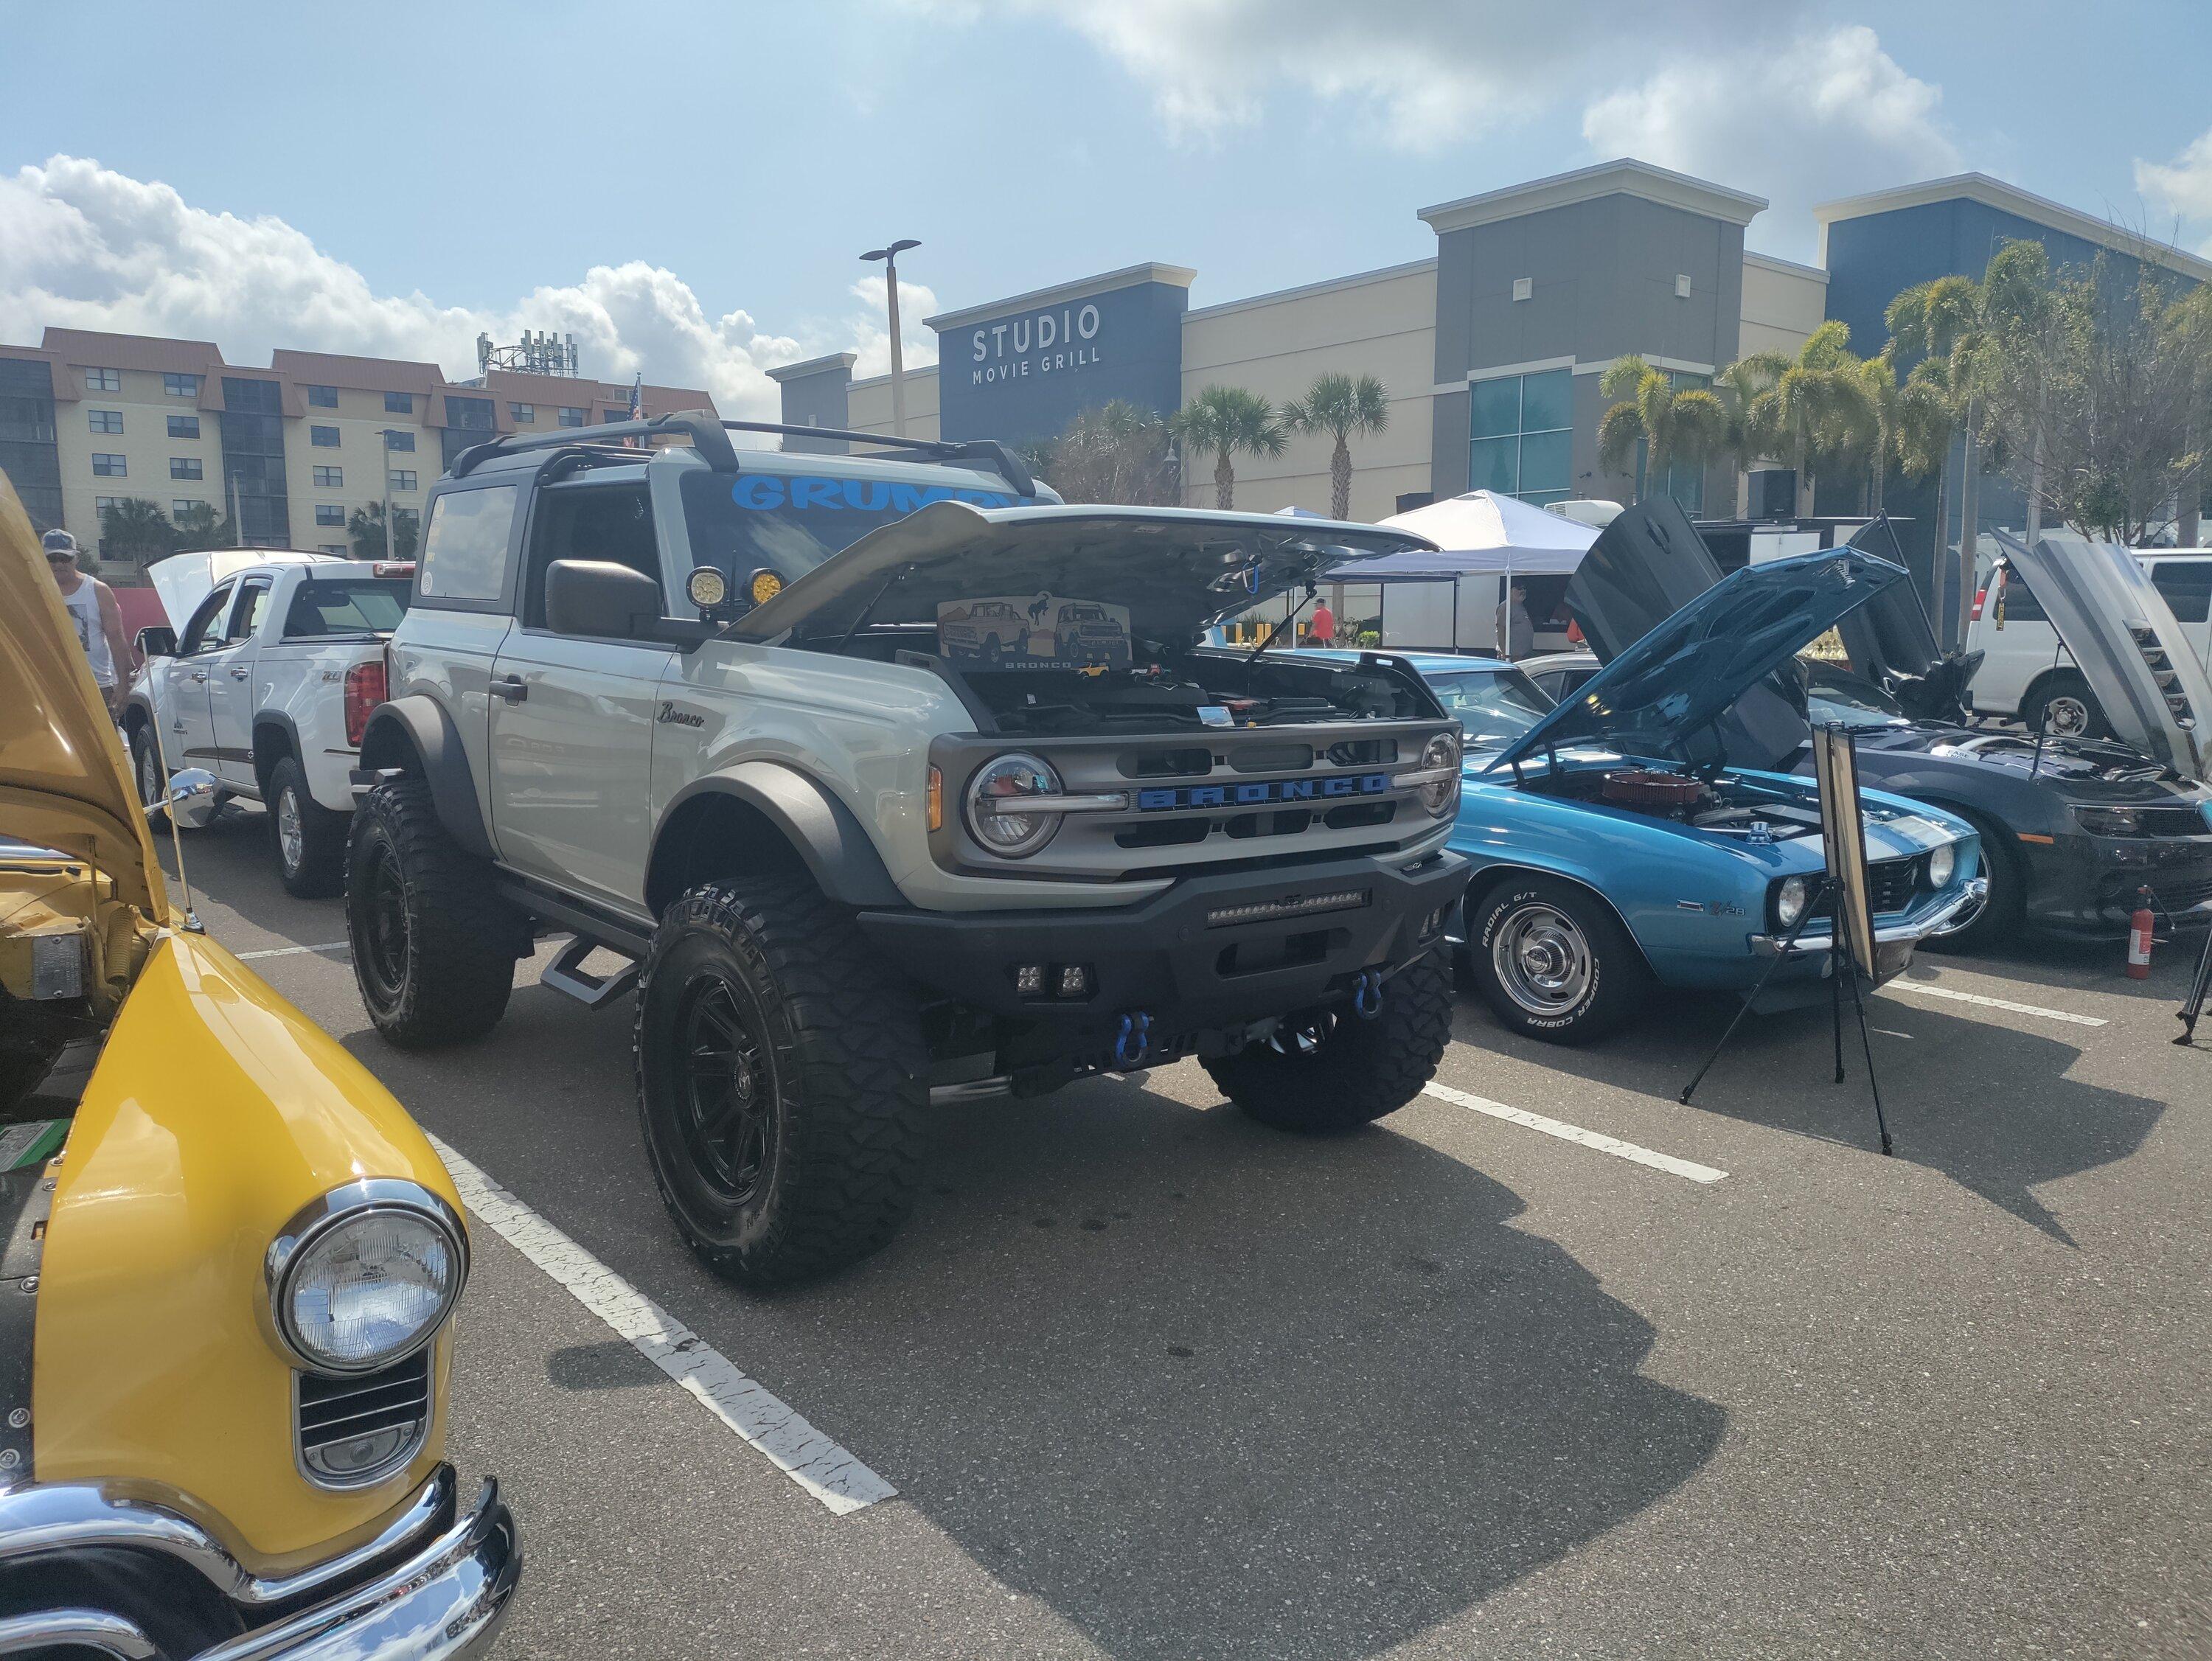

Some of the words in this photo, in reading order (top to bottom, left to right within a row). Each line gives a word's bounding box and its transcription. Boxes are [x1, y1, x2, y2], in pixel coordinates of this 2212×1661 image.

[973, 304, 1100, 362] STUDIO
[973, 361, 1029, 385] MOVIE
[1042, 347, 1099, 372] GRILL
[656, 701, 705, 728] Bronco
[1139, 774, 1388, 809] BRONCO
[1482, 902, 1509, 948] RADIAL
[1513, 891, 1537, 902] G/T
[1577, 958, 1601, 1017] COOPER
[1526, 1016, 1573, 1028] COBRA
